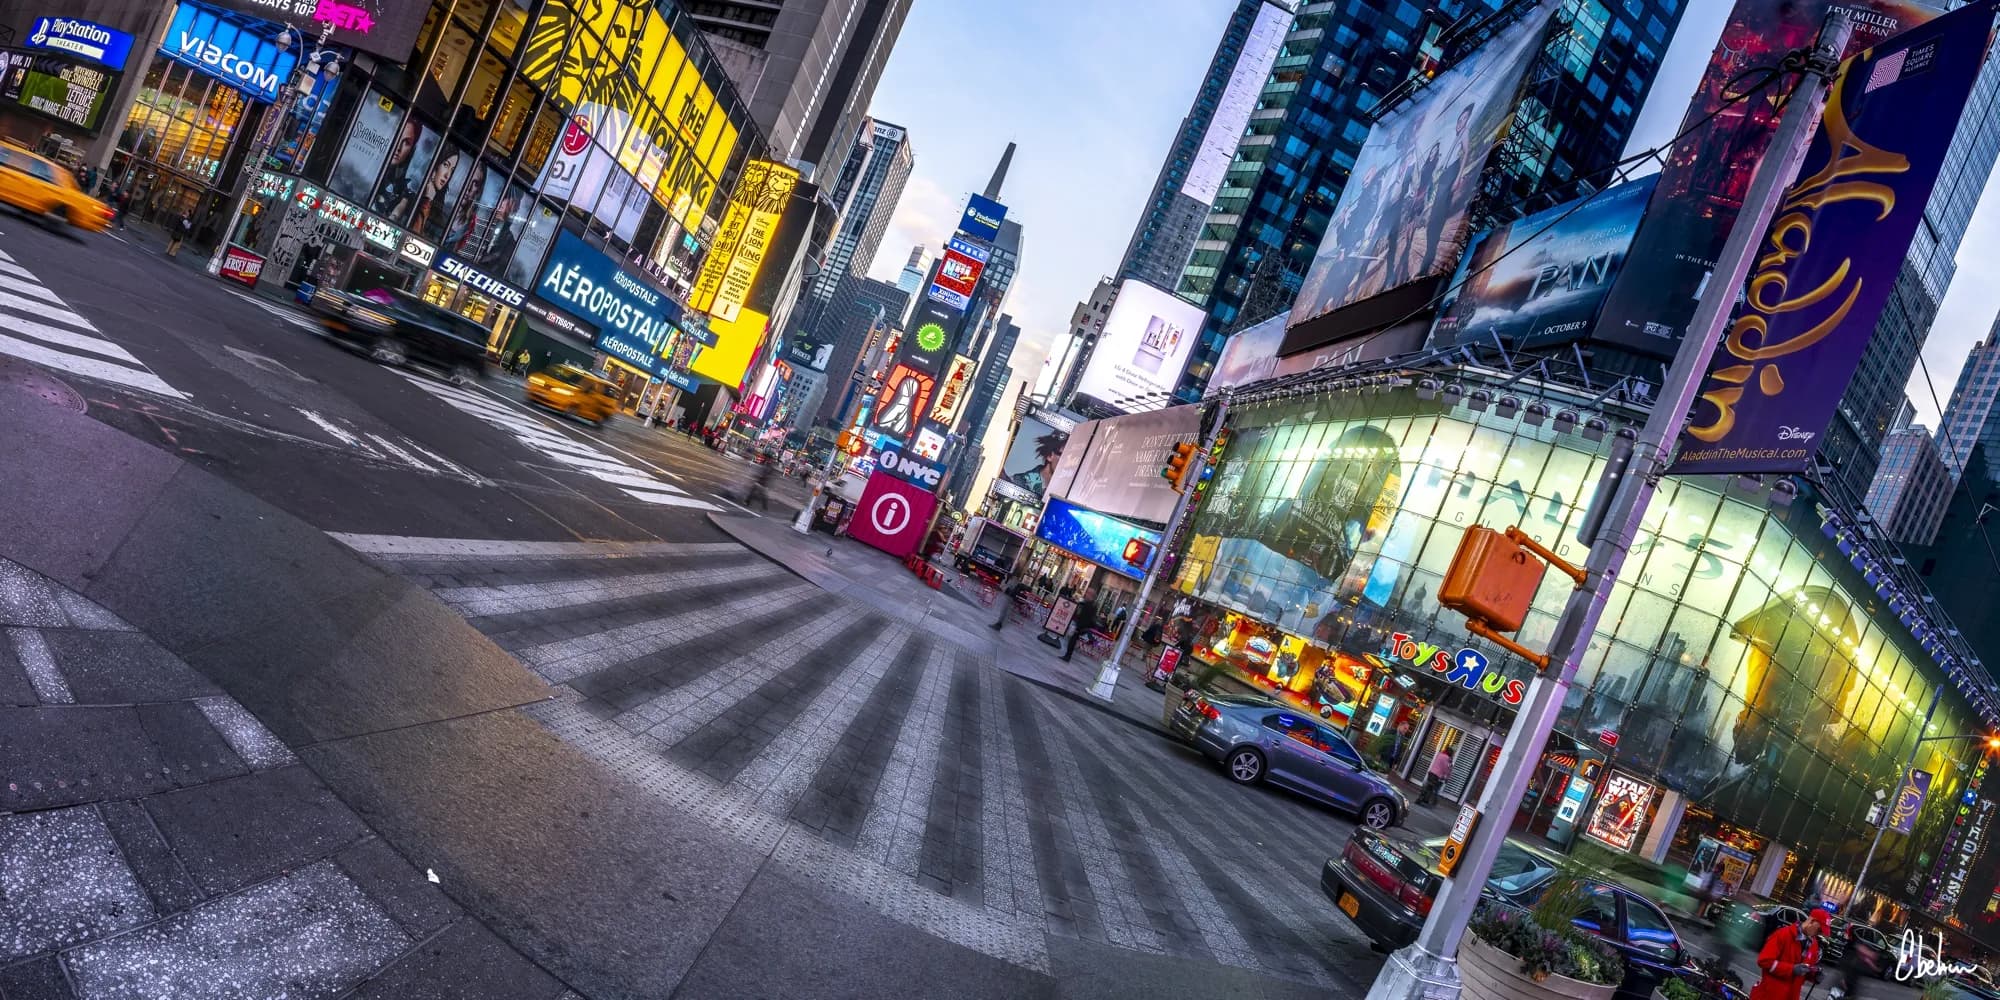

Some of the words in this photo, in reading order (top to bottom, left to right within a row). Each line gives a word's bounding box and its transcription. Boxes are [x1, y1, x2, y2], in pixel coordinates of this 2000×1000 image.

[1853, 12, 1898, 30] MILLER
[51, 19, 111, 46] PlayStation
[1869, 26, 1890, 37] PAN
[56, 39, 84, 51] THEATER
[1912, 44, 1935, 58] TIMES
[1904, 60, 1930, 72] ALLIANCE
[1905, 51, 1934, 67] SQUARE
[66, 89, 95, 109] LETTUCE
[745, 234, 764, 248] LION
[751, 227, 765, 238] THE
[738, 245, 761, 262] KING
[1687, 256, 1701, 265] THE
[223, 256, 246, 274] JERSEY
[439, 257, 525, 307] SKECHERS
[1528, 248, 1616, 301] PAN
[613, 271, 659, 307] AÉROPOSTALE
[938, 288, 960, 302] XINHUA
[544, 263, 662, 356] AÉROPOSTAL
[554, 312, 575, 331] TISSOT
[1544, 322, 1580, 335] OCTOBER
[1581, 320, 1587, 328] 9
[602, 335, 654, 368] AÉROPOSTALE
[1680, 448, 1807, 463] AladdinTheMusical.com
[897, 457, 941, 485] NYC
[1391, 632, 1451, 673] TOYS
[1482, 671, 1526, 704] US
[1591, 828, 1609, 841] NOW
